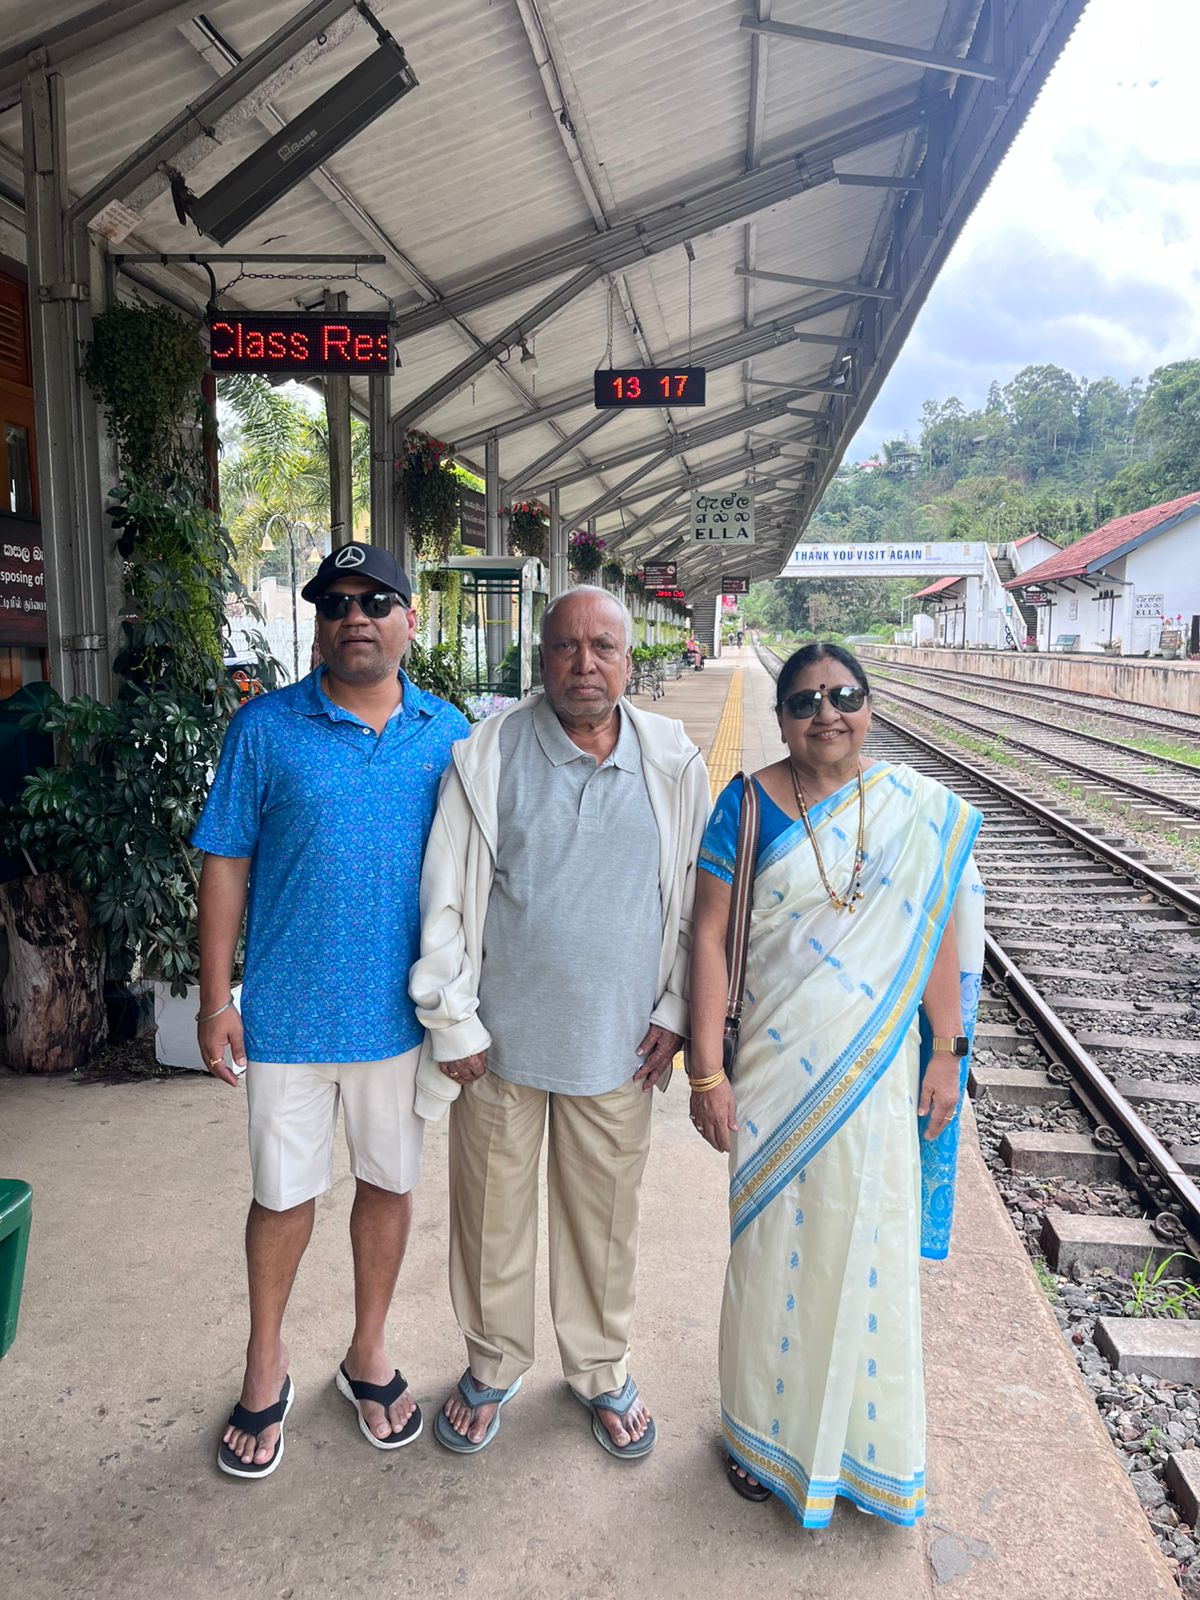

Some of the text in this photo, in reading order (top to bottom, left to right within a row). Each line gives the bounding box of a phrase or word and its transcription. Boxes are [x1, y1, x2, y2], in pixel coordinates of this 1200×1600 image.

[212, 322, 309, 360] Class
[612, 375, 689, 399] 13 17
[695, 527, 749, 540] ELLA
[795, 549, 923, 561] THANK YOU VISIT AGAIN
[0, 570, 44, 587] sposing of
[740, 580, 748, 592] 1
[1040, 592, 1048, 602] 2
